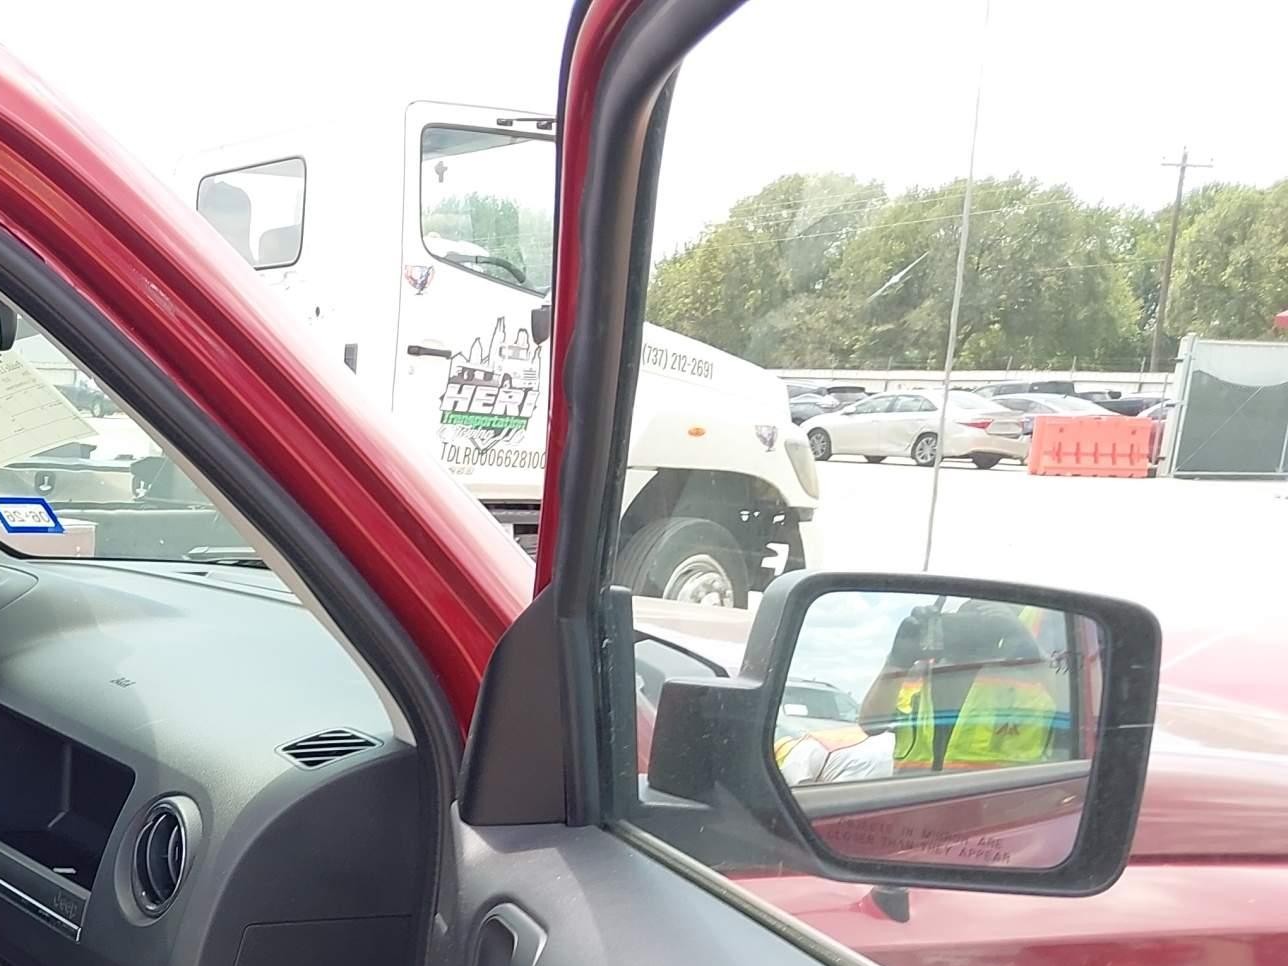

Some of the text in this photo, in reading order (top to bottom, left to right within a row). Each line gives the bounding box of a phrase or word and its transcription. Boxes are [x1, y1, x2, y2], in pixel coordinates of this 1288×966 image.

[642, 343, 714, 380] (737) 212-2691
[440, 384, 540, 418] HERI
